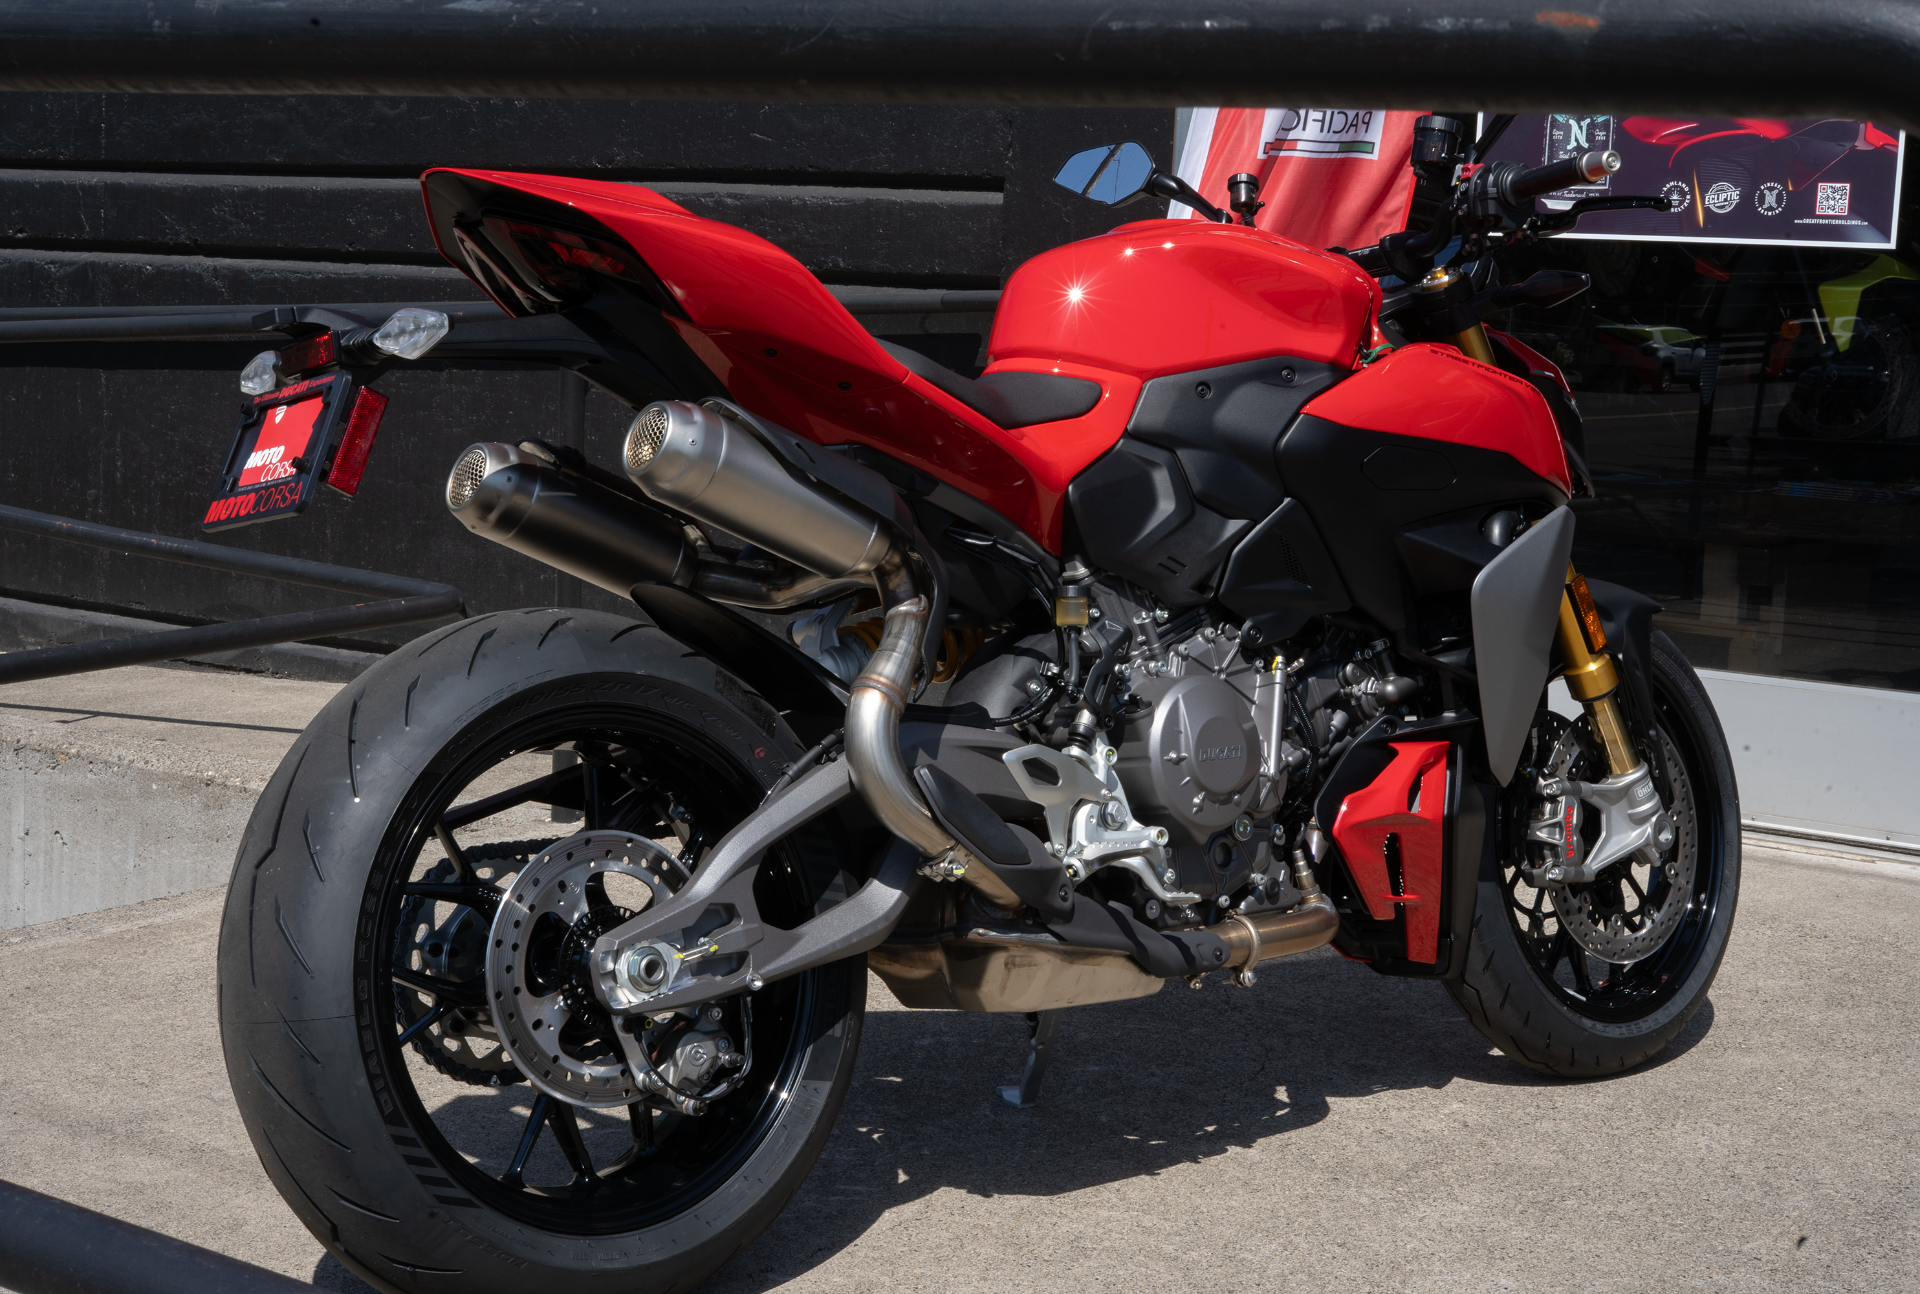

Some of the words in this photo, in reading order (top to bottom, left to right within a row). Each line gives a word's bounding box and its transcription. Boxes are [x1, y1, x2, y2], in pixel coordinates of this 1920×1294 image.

[1662, 180, 1690, 192] ASHLAND
[1670, 194, 1691, 213] SELTZER
[1705, 190, 1740, 205] ECLIPTIC
[278, 380, 310, 399] DUCATI
[243, 445, 285, 470] MOTO
[203, 481, 303, 524] MOTOCORSA
[1199, 745, 1244, 762] DUCATI
[1563, 806, 1574, 858] brembo
[357, 976, 394, 1116] DIABLO
